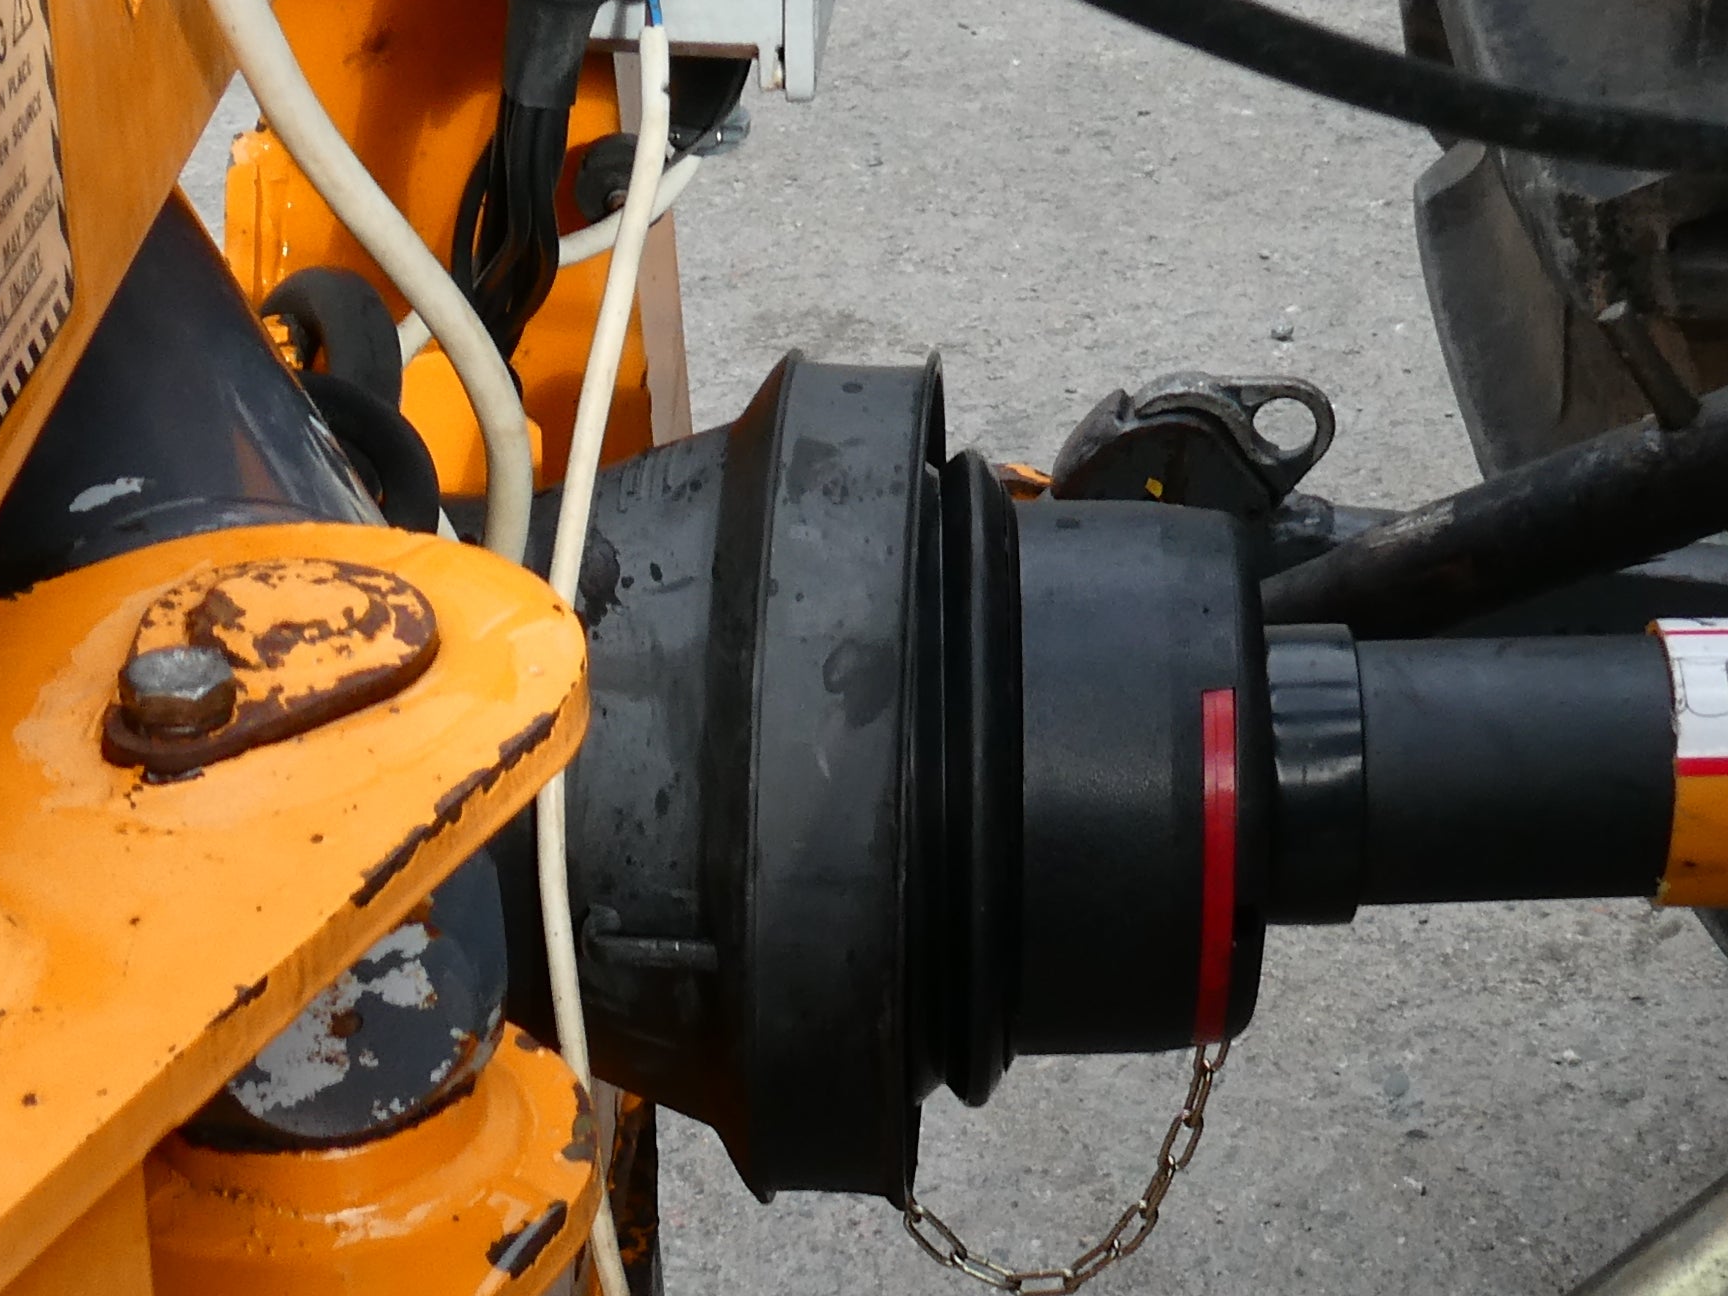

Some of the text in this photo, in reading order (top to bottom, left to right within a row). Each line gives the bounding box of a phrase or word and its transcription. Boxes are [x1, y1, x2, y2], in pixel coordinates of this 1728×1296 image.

[6, 53, 33, 100] PLACE
[10, 90, 43, 147] SOURCE
[1, 223, 23, 273] MAY
[22, 175, 55, 242] RESULT
[8, 243, 43, 314] INJURY
